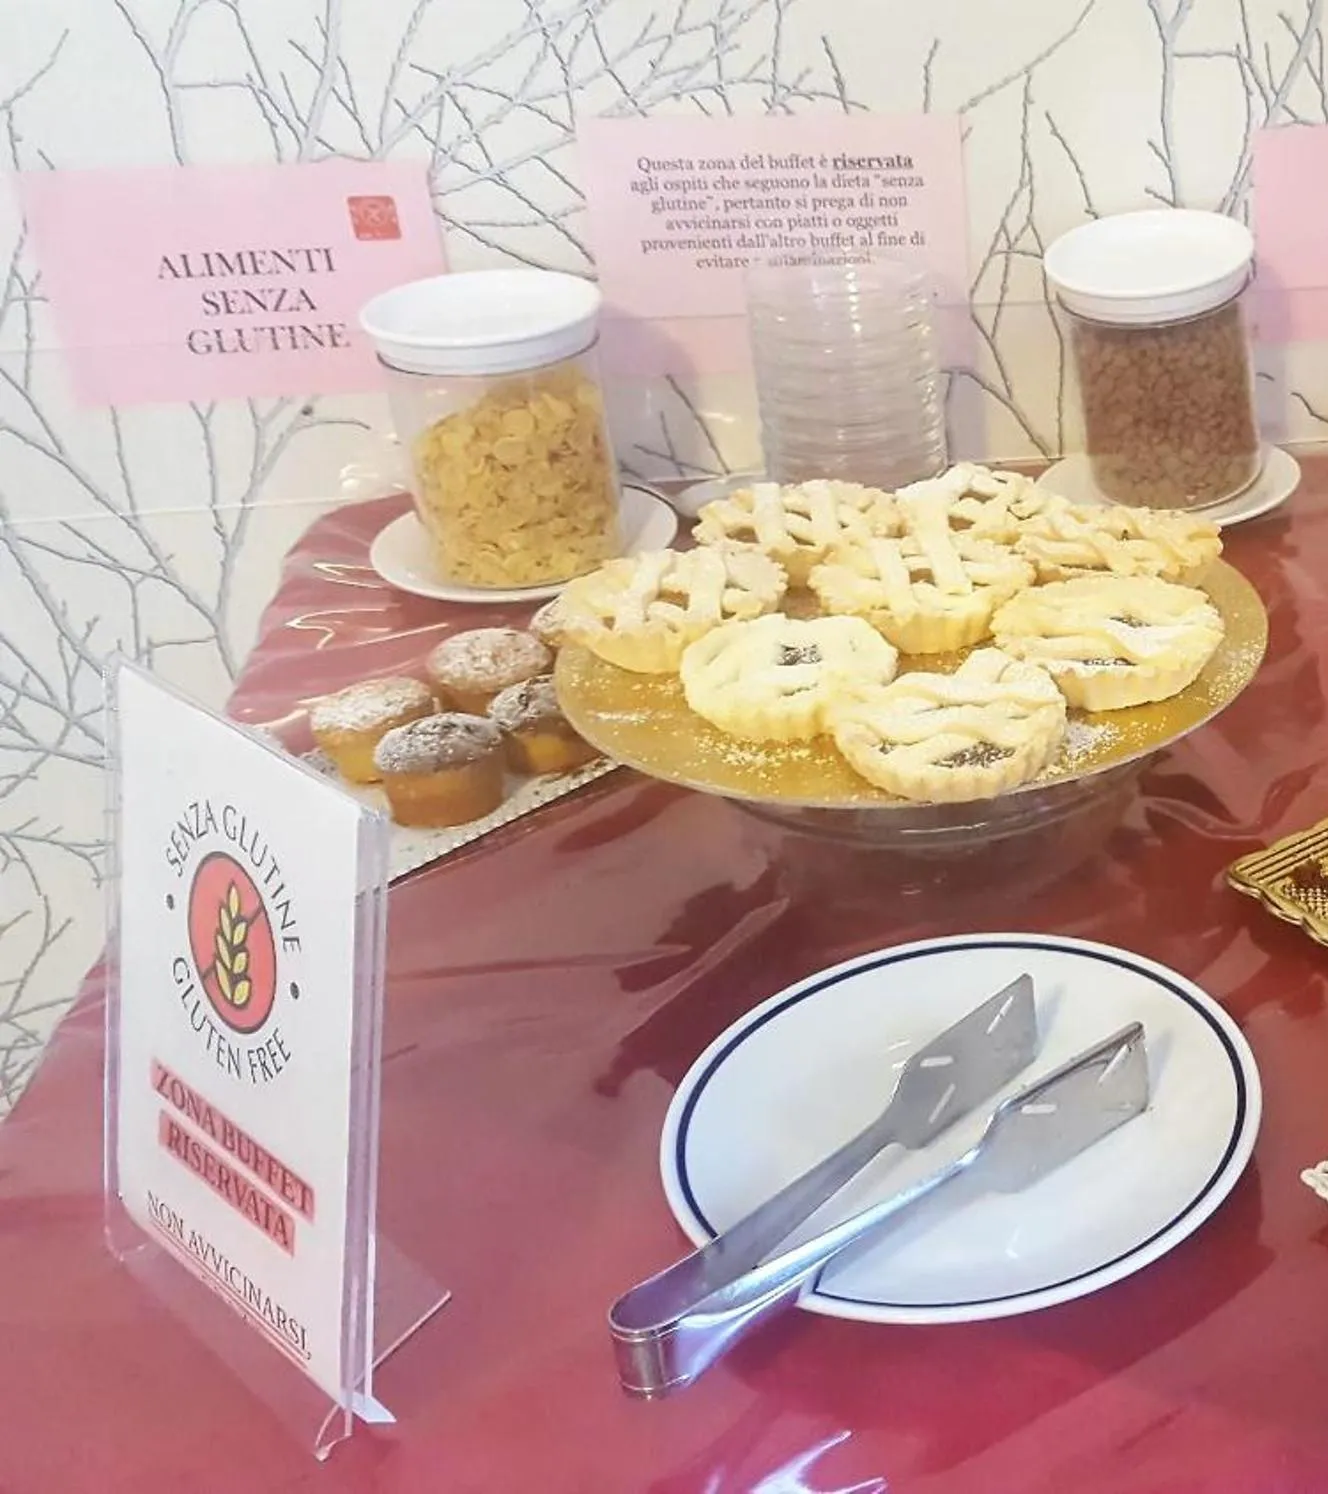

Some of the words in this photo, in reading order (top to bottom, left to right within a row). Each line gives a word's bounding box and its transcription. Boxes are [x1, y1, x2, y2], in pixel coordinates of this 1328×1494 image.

[637, 157, 694, 173] Questa
[698, 158, 736, 170] zona
[740, 155, 764, 170] del
[767, 154, 815, 170] buffet
[819, 154, 828, 169] è
[832, 153, 914, 171] riservata
[630, 177, 659, 195] agli
[663, 178, 708, 194] ospiti
[713, 175, 740, 190] che
[744, 178, 810, 193] seguono
[813, 173, 828, 188] la
[831, 173, 870, 188] dieta
[723, 196, 790, 213] pertanto
[795, 194, 807, 209] si
[811, 197, 854, 212] prega
[859, 192, 874, 208] di
[879, 196, 907, 208] non
[665, 215, 751, 231] avvicinarsi
[754, 218, 783, 229] con
[787, 213, 828, 232] piatti
[832, 218, 842, 228] o
[845, 212, 899, 231] oggetti
[640, 236, 733, 254] provenienti
[736, 232, 807, 249] dall'altro
[810, 231, 854, 248] buffet
[859, 231, 873, 246] al
[877, 231, 906, 246] fine
[910, 230, 926, 246] di
[158, 247, 336, 280] ALIMENTI
[696, 255, 749, 268] evitare
[201, 287, 317, 317] SENZA
[186, 322, 352, 356] GLUTINE
[165, 799, 218, 877] SENZA
[222, 804, 302, 954] GLUTINE
[172, 957, 242, 1080] GLUTEN
[247, 1027, 292, 1086] FREE
[157, 1064, 217, 1139] ZONA
[222, 1115, 314, 1215] BUFFET
[167, 1120, 289, 1248] RISERVATA
[147, 1189, 185, 1241] NON
